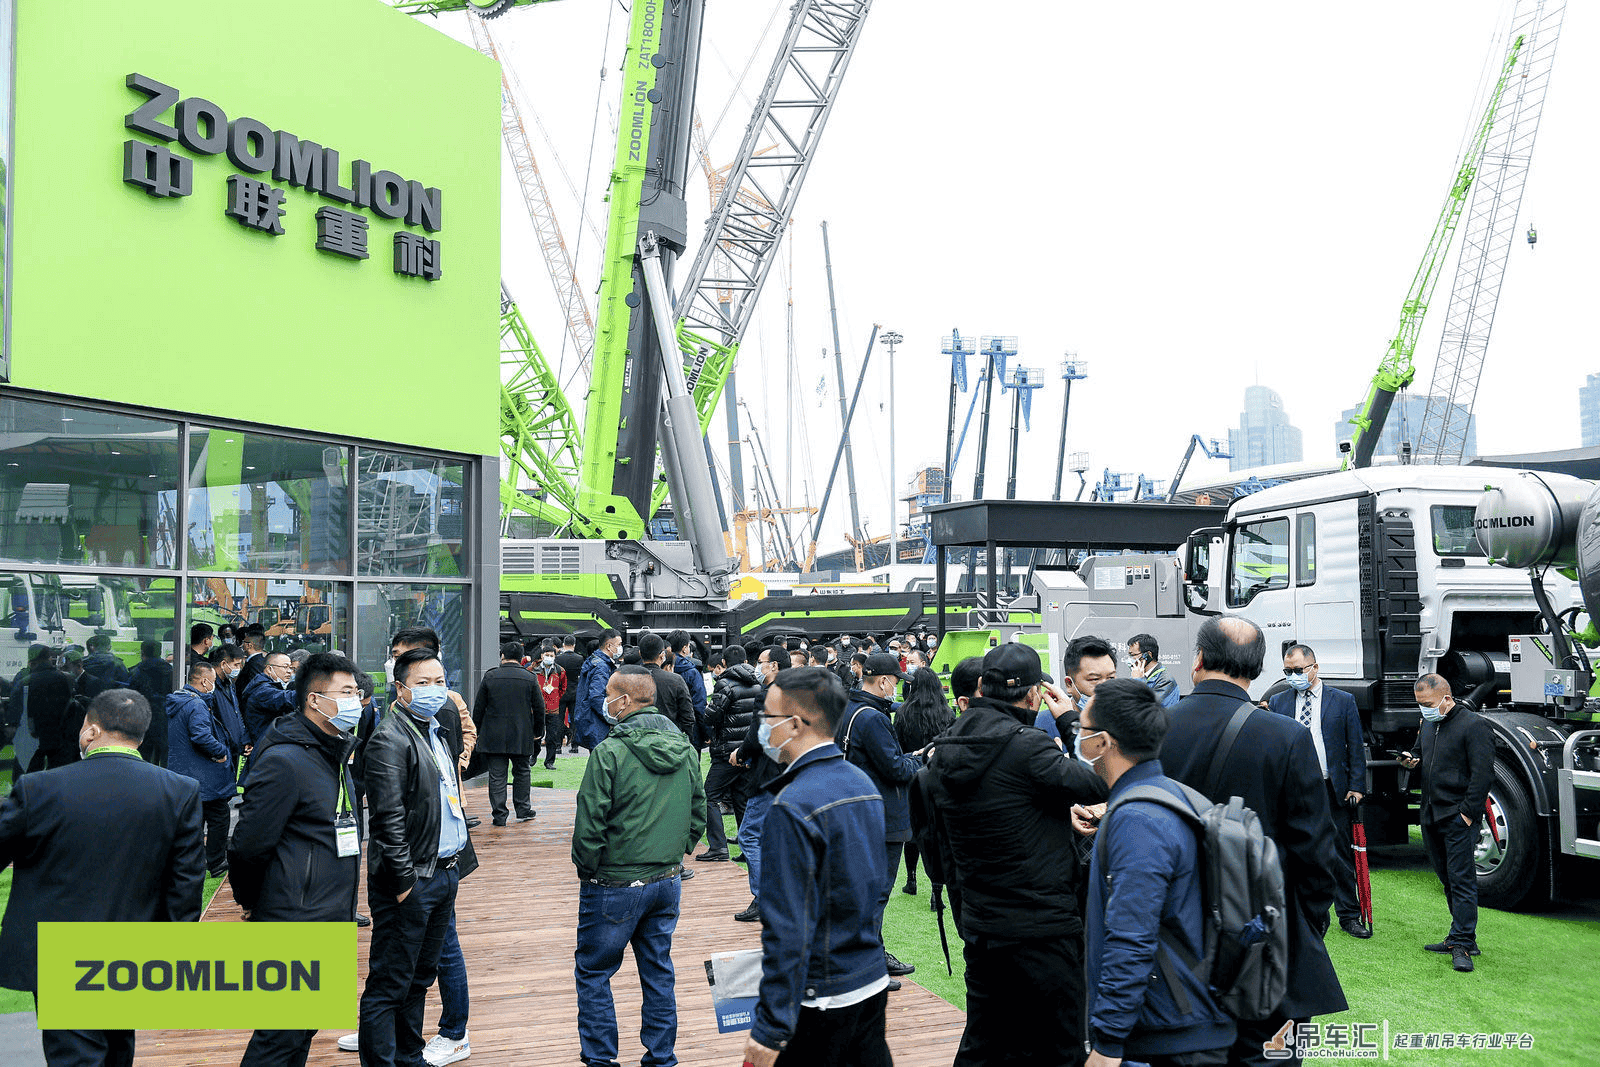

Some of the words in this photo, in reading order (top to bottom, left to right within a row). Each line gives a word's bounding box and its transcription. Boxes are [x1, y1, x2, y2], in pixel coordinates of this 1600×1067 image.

[125, 73, 442, 232] ZOOMLION
[629, 80, 648, 162] ZOOMLION
[123, 140, 442, 282] 中联重科
[687, 347, 709, 396] OMLION
